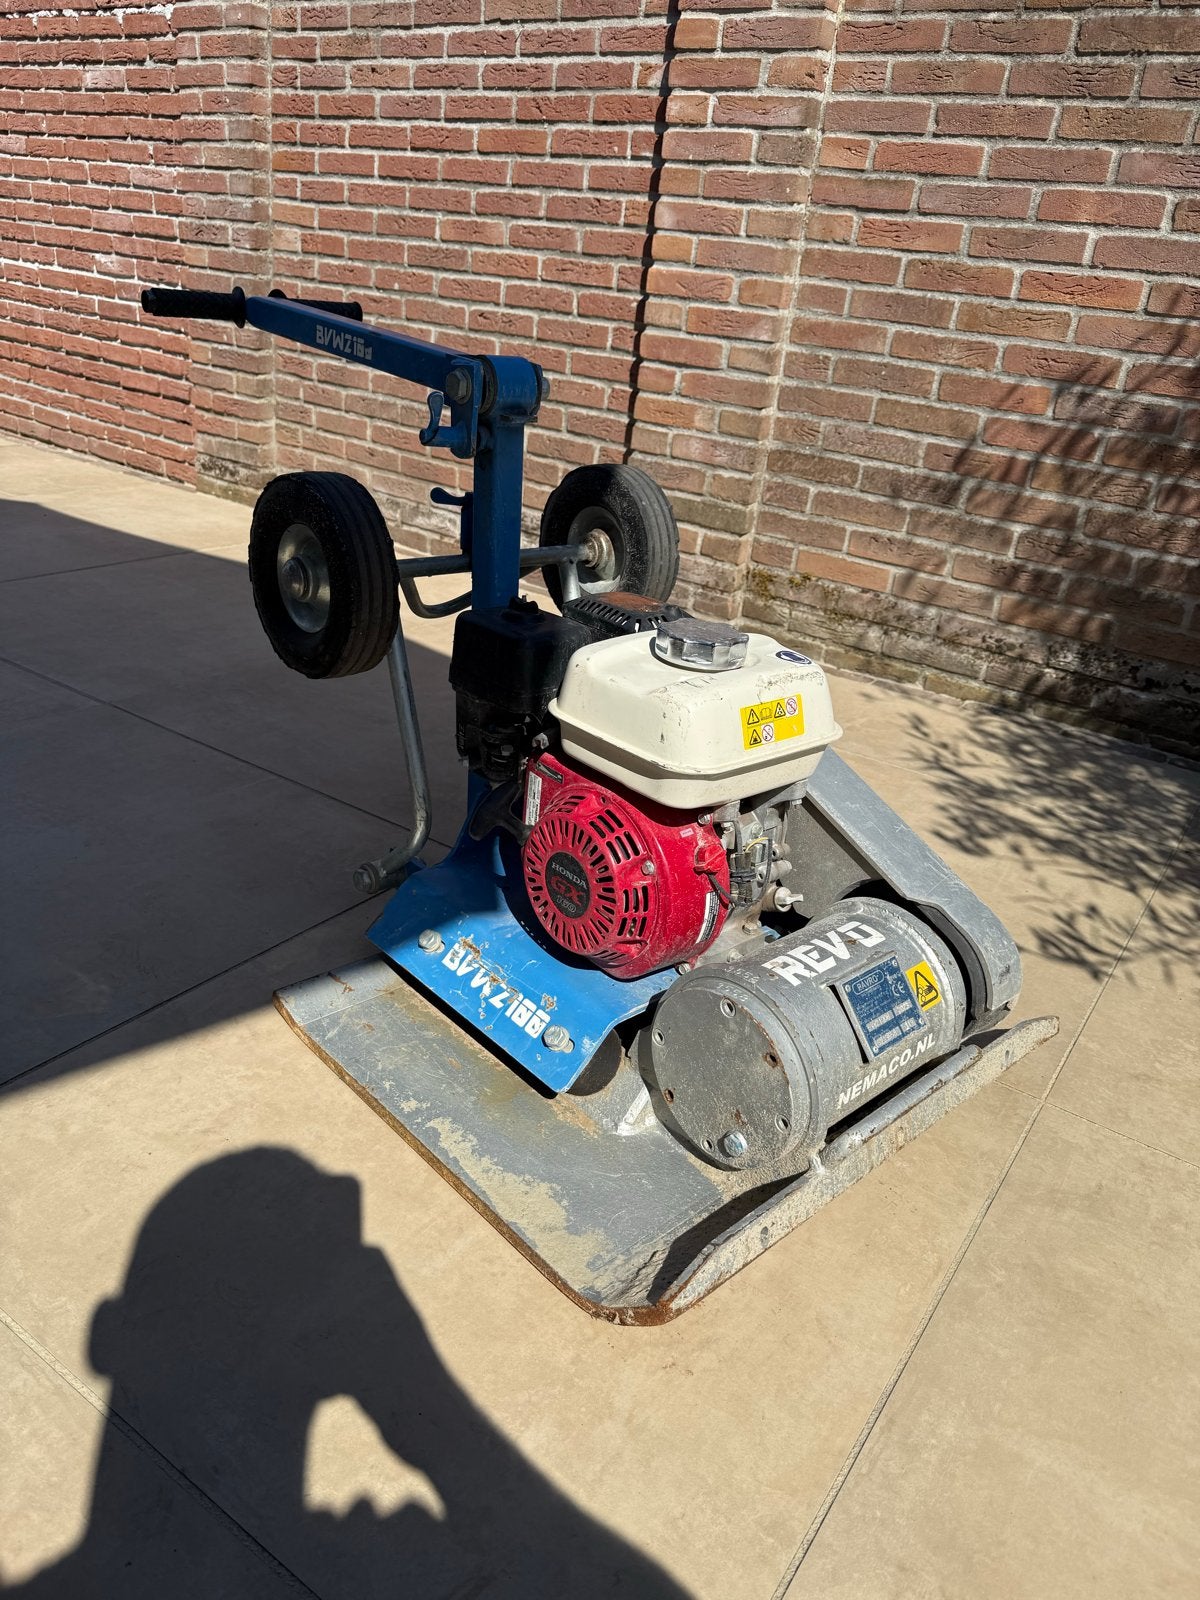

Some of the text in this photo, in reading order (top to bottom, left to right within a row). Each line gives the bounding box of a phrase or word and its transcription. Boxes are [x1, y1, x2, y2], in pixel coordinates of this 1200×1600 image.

[551, 861, 588, 890] HONDA
[552, 876, 587, 906] GX
[761, 920, 886, 988] REVO
[837, 1034, 936, 1109] NEMACO.NL
